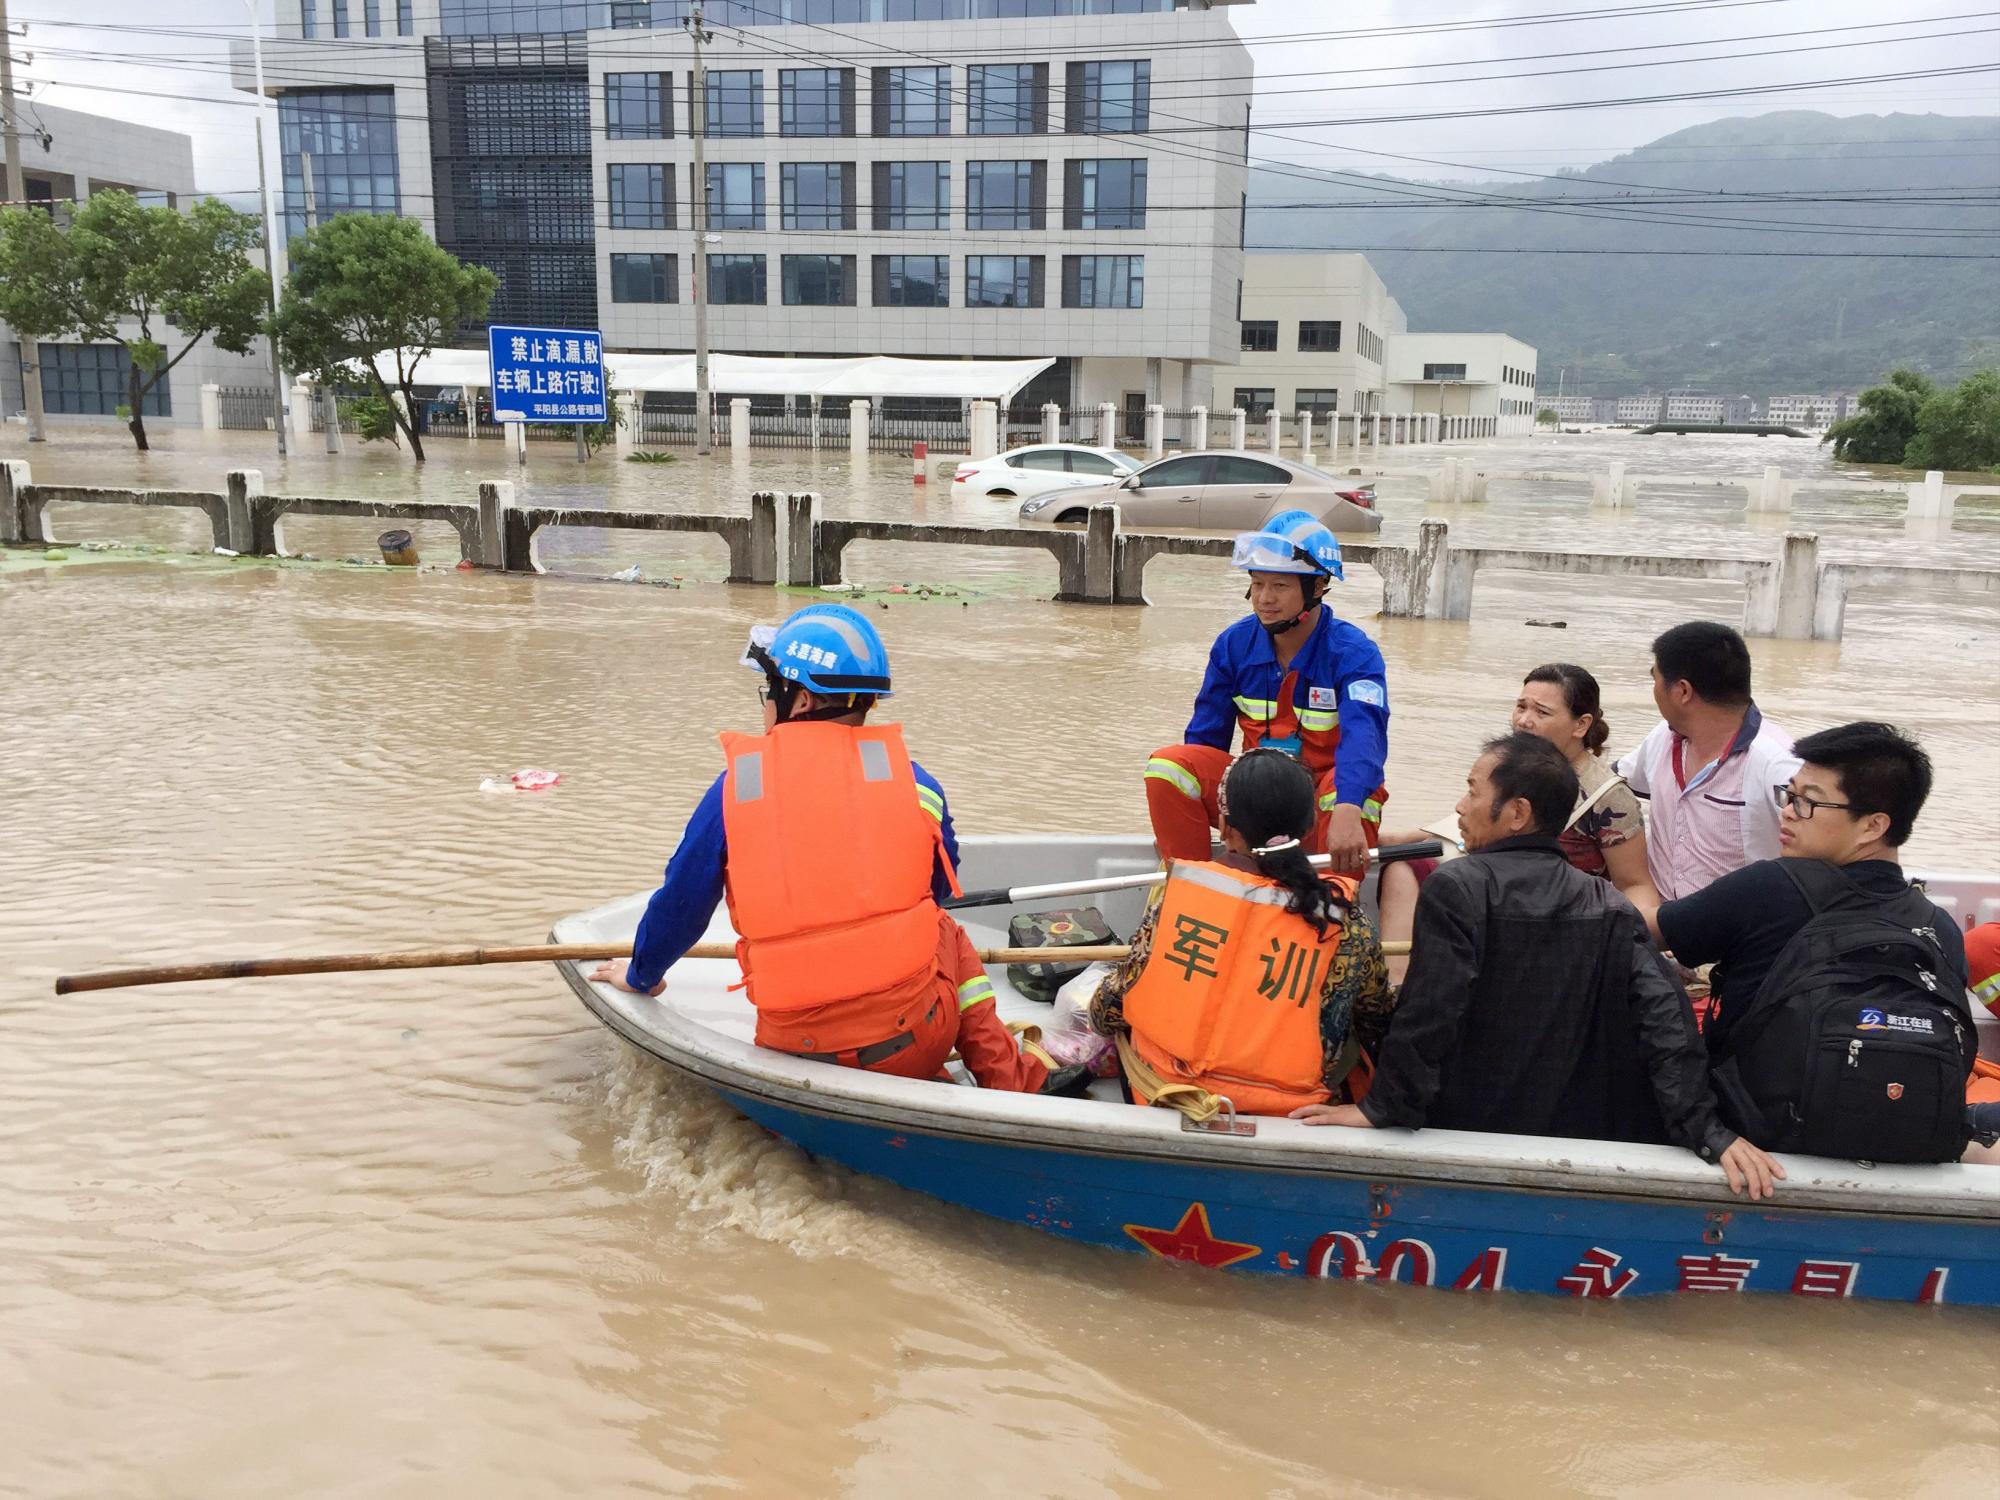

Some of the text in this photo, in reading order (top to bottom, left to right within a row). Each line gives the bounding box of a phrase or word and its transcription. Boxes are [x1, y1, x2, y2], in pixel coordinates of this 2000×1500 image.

[497, 368, 600, 395] 车辆上路行驶!
[784, 666, 799, 680] 19
[1164, 913, 1321, 1008] 军训
